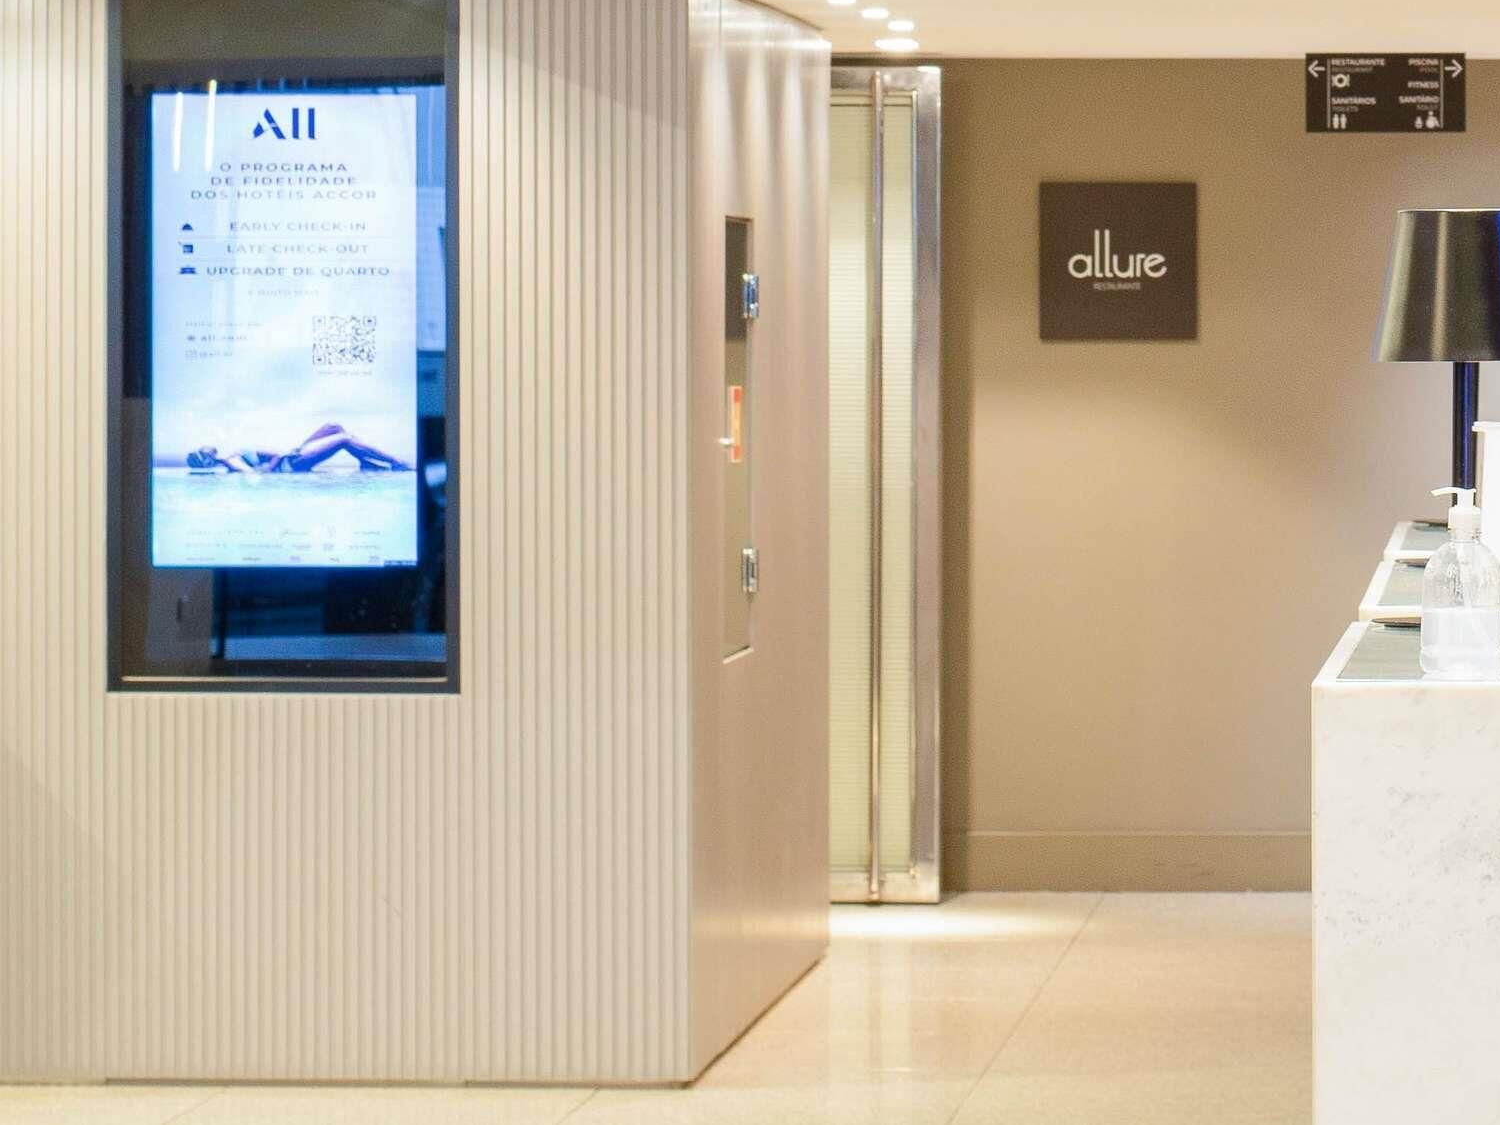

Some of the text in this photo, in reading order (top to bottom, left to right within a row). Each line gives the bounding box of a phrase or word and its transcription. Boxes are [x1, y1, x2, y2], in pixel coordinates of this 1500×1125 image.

[1408, 81, 1439, 89] FITNESS
[219, 162, 348, 173] O PROGRAMA
[210, 176, 357, 186] DE FIDELIDADE
[190, 190, 229, 200] DOS
[311, 190, 377, 200] ACCOR
[229, 221, 366, 231] EARLY CHECK-IN
[226, 244, 266, 254] LATE
[1067, 229, 1168, 279] allure
[206, 266, 390, 277] UPGRADE DE QUARTO
